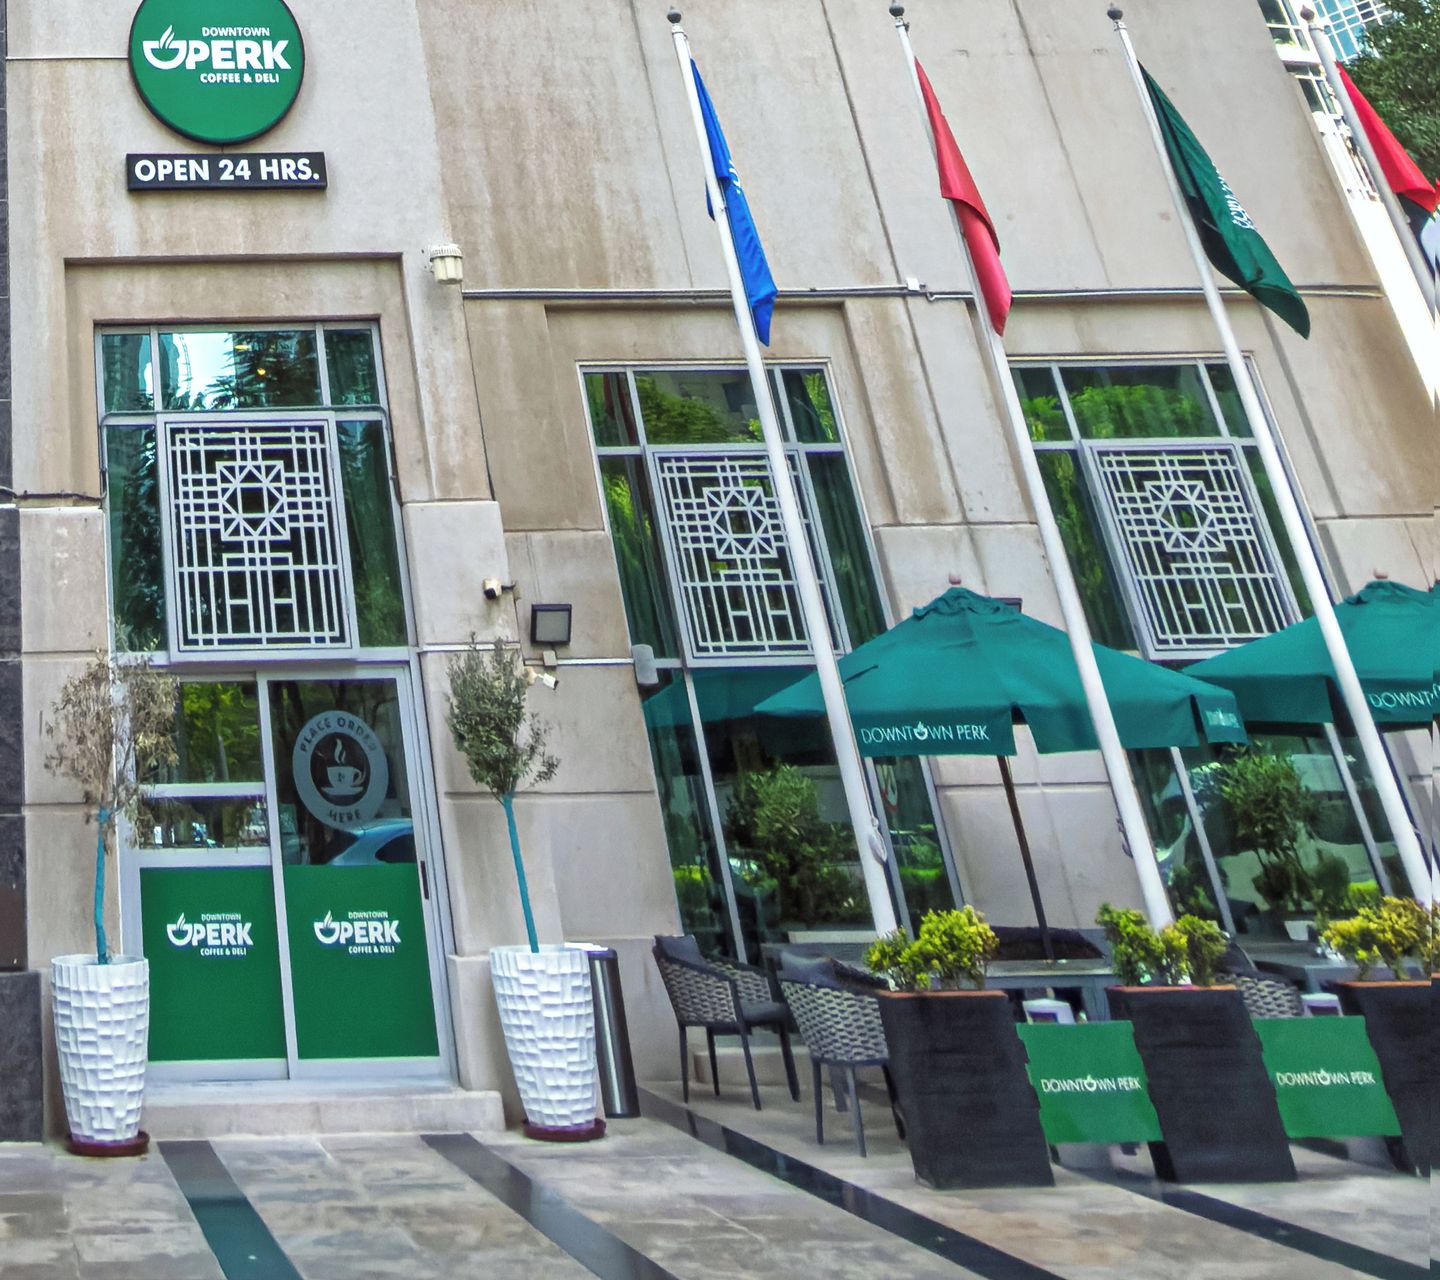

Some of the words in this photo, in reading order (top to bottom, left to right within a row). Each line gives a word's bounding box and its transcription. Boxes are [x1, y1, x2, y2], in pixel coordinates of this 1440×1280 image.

[202, 26, 270, 37] DOWNTOWN
[200, 72, 241, 83] COFFEE
[243, 72, 252, 83] &
[254, 72, 279, 83] DELI
[134, 159, 210, 182] OPEN
[218, 159, 252, 181] 24
[259, 158, 320, 181] HRS.
[300, 717, 332, 753] PLACE
[861, 721, 954, 744] DOWNTOWN
[956, 724, 990, 741] PERK
[201, 913, 242, 922] DOWNTOWN
[348, 911, 389, 919] DOWNTOWN
[200, 948, 224, 956] COFFEE
[232, 947, 247, 956] DELI
[348, 945, 372, 954] COFFEE
[380, 945, 395, 953] DELI
[1276, 1068, 1350, 1087] DOWNTOWN
[1350, 1071, 1376, 1085] PERK
[1040, 1074, 1117, 1093] DOWNTOWN
[1117, 1076, 1142, 1091] PERK
